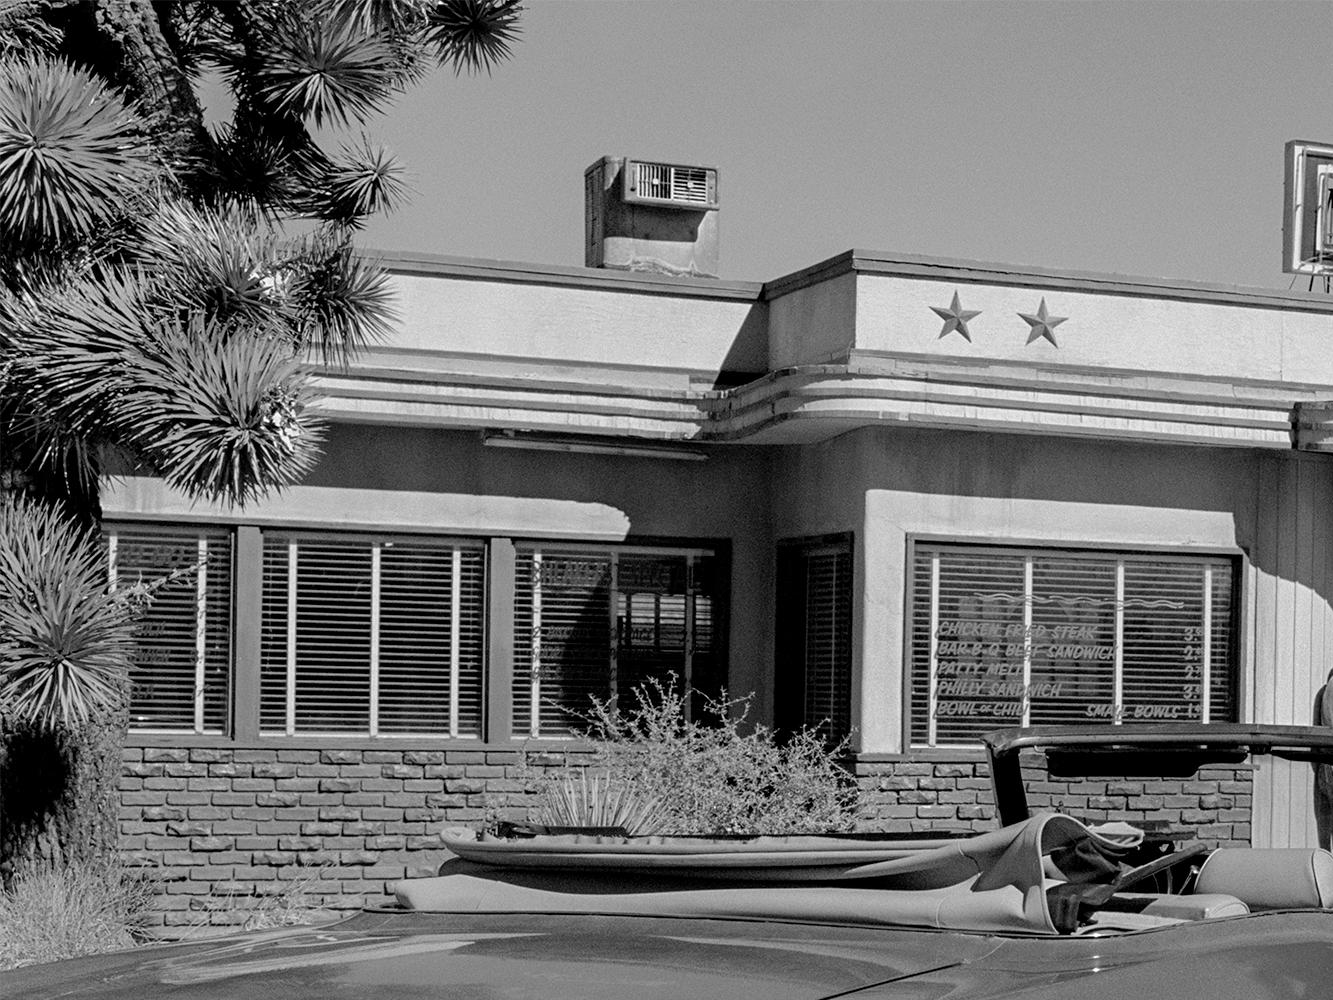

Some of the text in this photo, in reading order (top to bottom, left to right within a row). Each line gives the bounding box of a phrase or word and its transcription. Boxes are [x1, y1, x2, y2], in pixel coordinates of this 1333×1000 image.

[939, 621, 1001, 637] CHICKEN
[1051, 624, 1098, 640] STEAK
[1047, 643, 1117, 660] SANDWICH
[938, 661, 983, 676] PATTY
[986, 662, 1024, 677] MELT
[938, 681, 985, 697] PHILLY
[937, 701, 979, 716] BOWL
[1134, 704, 1181, 719] BOWLS
